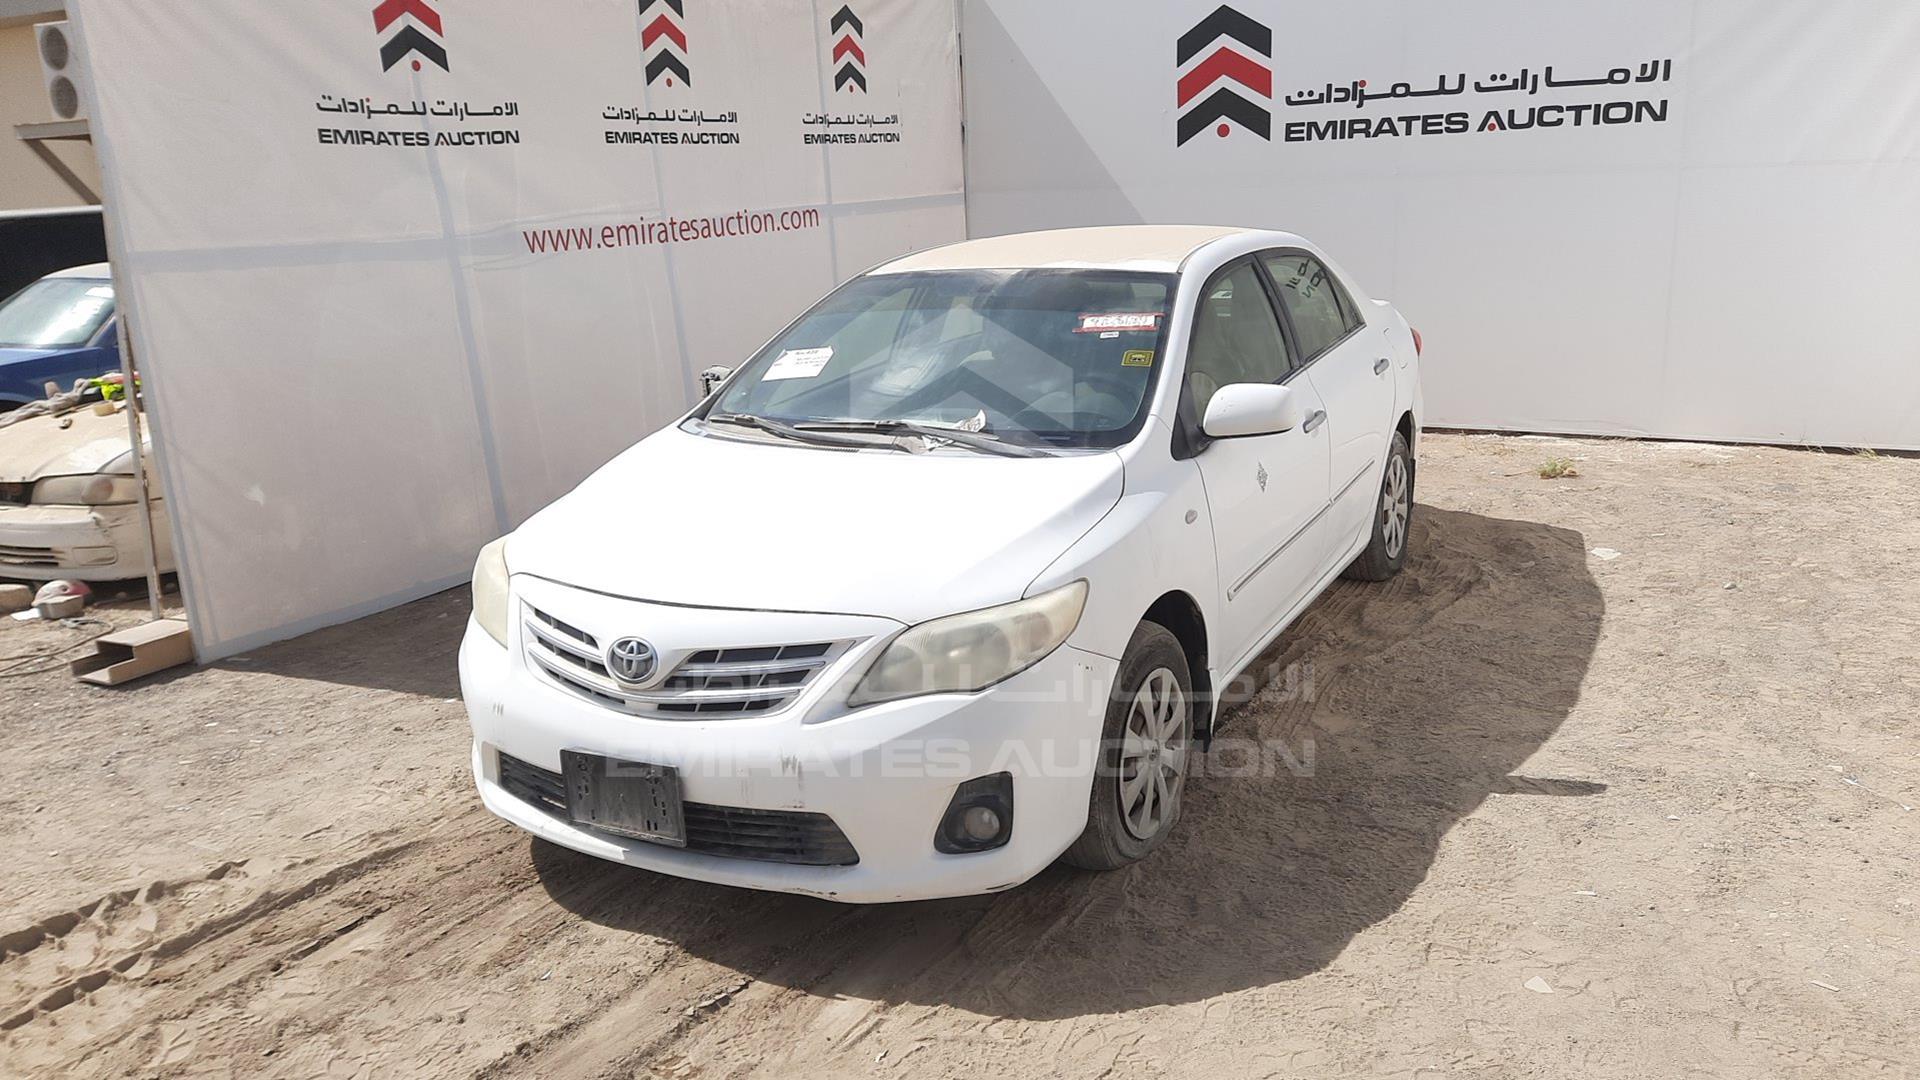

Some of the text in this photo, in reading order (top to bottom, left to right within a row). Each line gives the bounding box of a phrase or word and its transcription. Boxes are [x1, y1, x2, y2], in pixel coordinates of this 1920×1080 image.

[1284, 99, 1668, 142] EMIRATES AUCTION
[317, 128, 520, 146] EMIRATES AUCTION
[605, 131, 740, 144] EMIRATES AUCTION
[803, 132, 900, 144] EMIRATES AUCTION
[523, 207, 820, 254] www.emiratesauction.com
